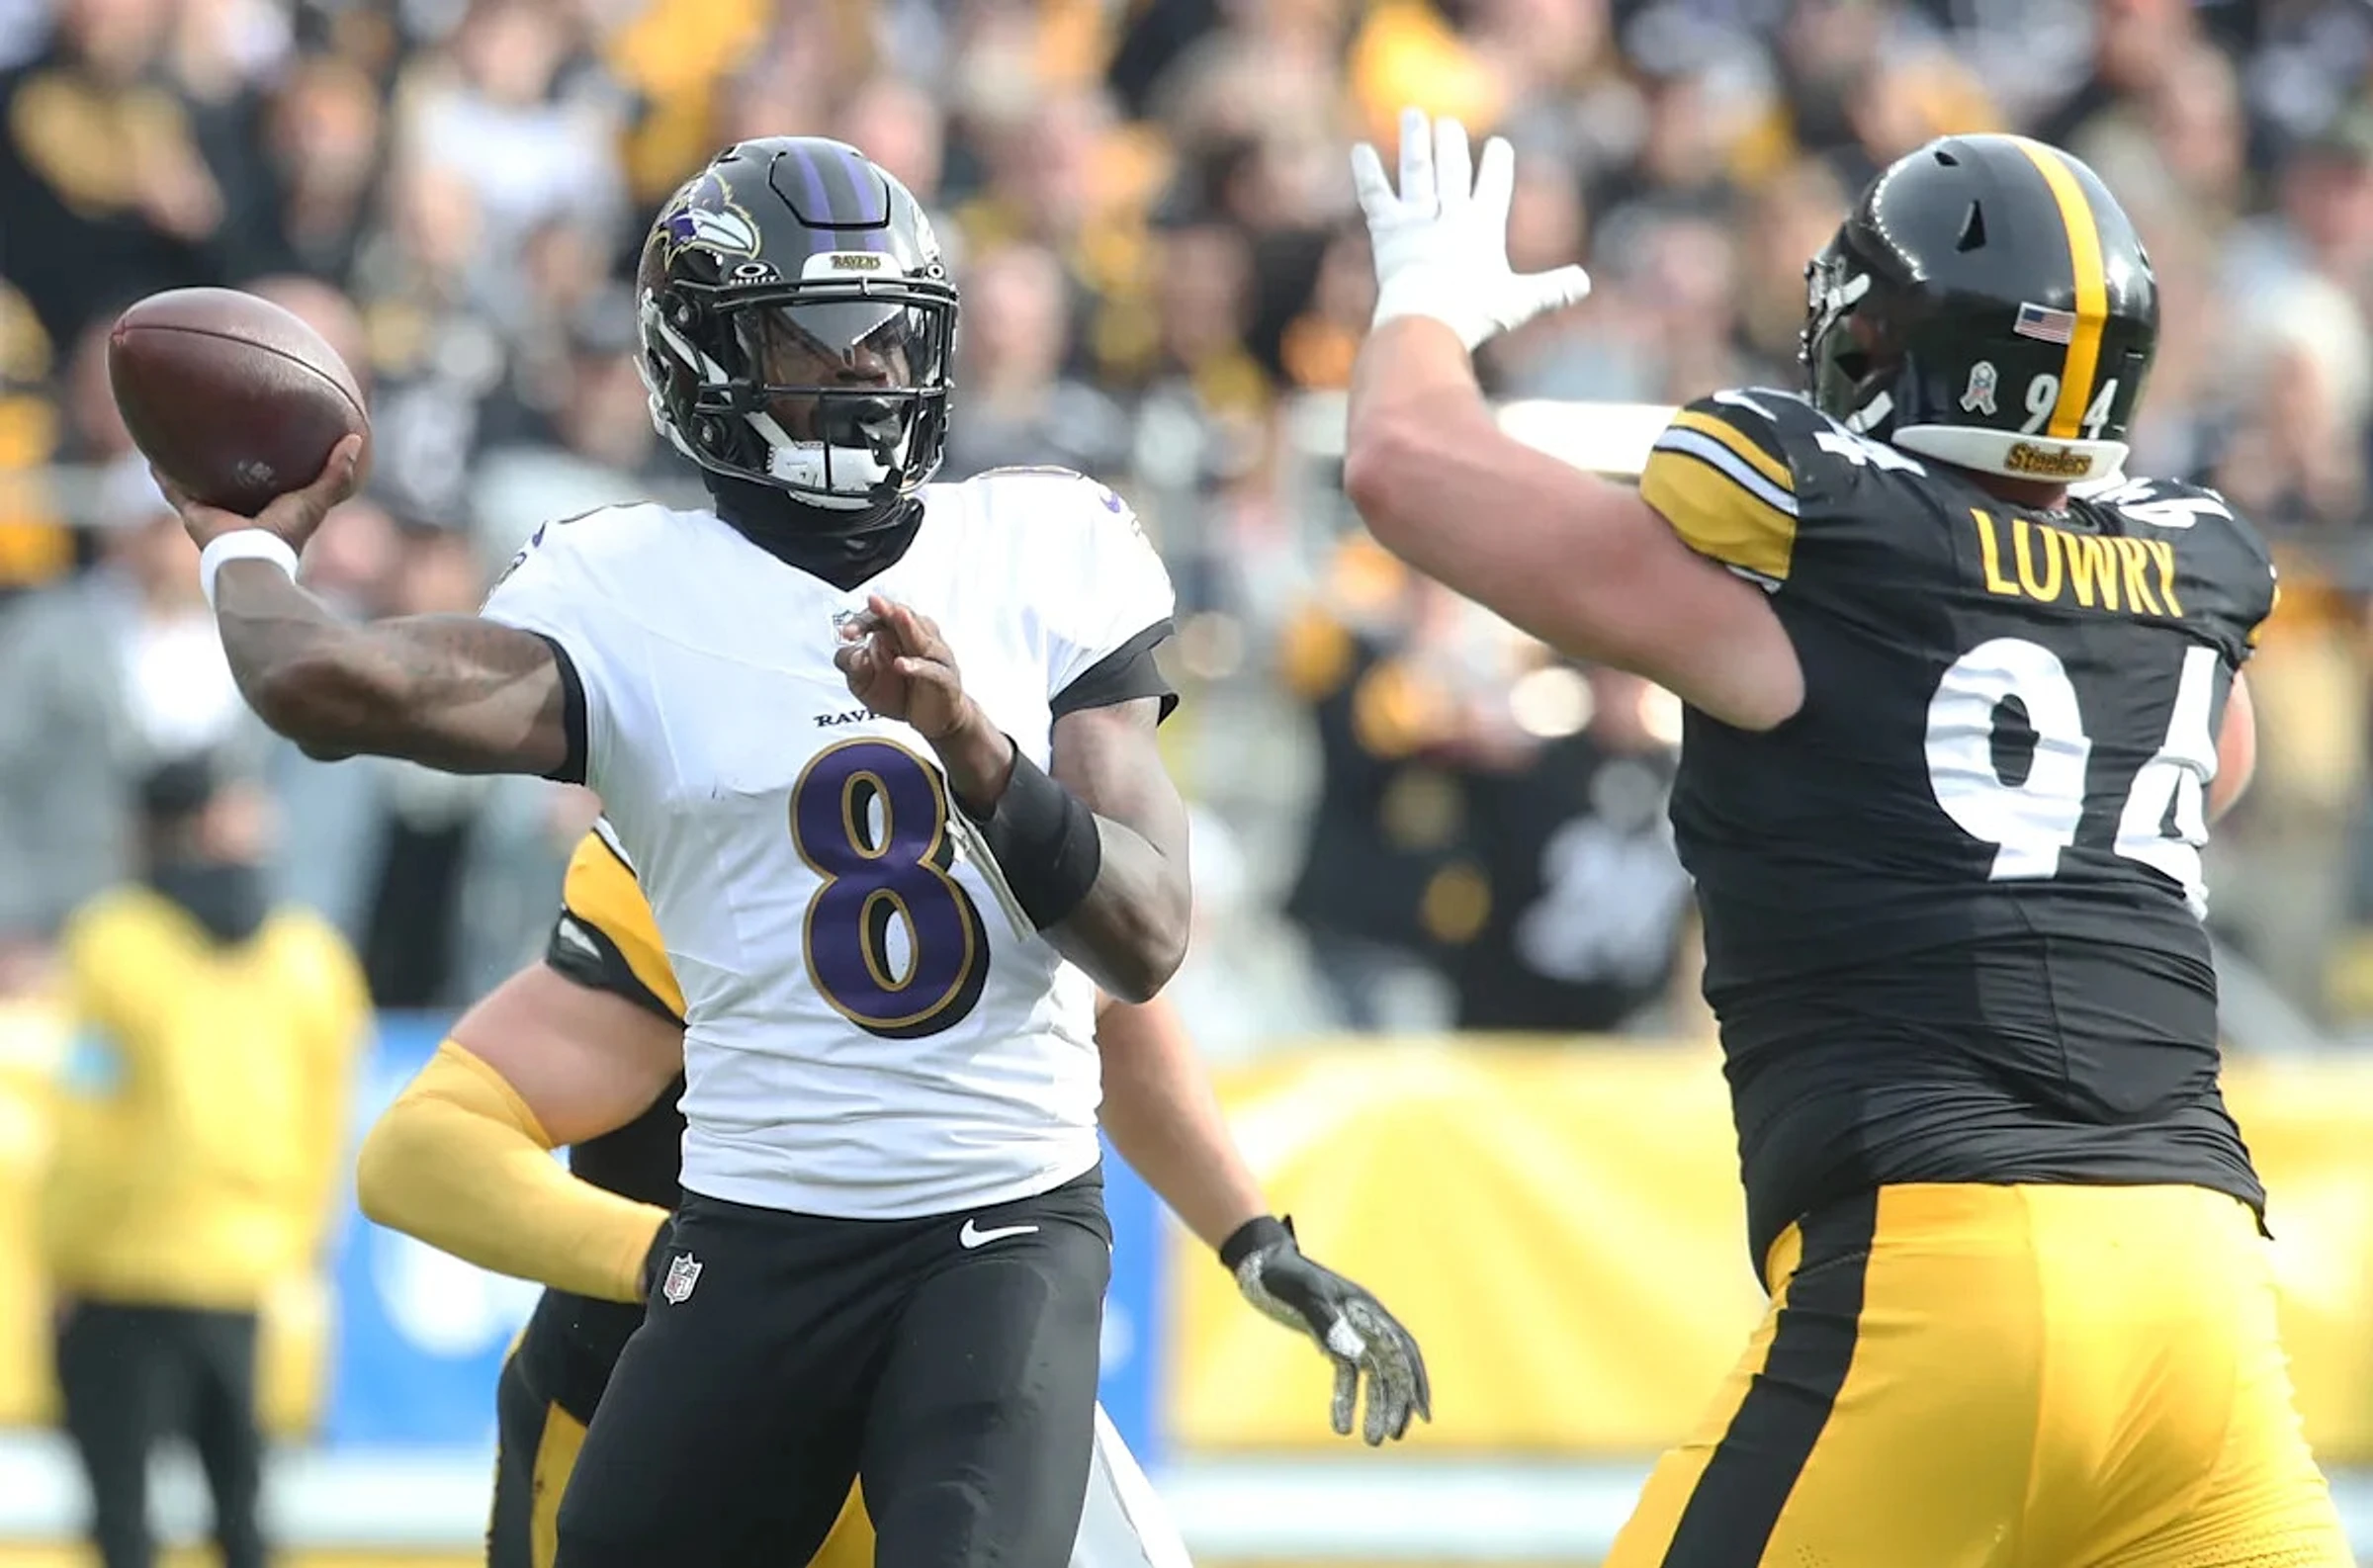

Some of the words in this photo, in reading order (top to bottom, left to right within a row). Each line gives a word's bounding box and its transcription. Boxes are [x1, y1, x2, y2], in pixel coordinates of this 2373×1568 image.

[2004, 442, 2093, 476] Steelers
[2019, 374, 2118, 440] 94
[1970, 507, 2183, 617] LOWRY
[1923, 637, 2211, 922] 94
[790, 736, 991, 1040] 8
